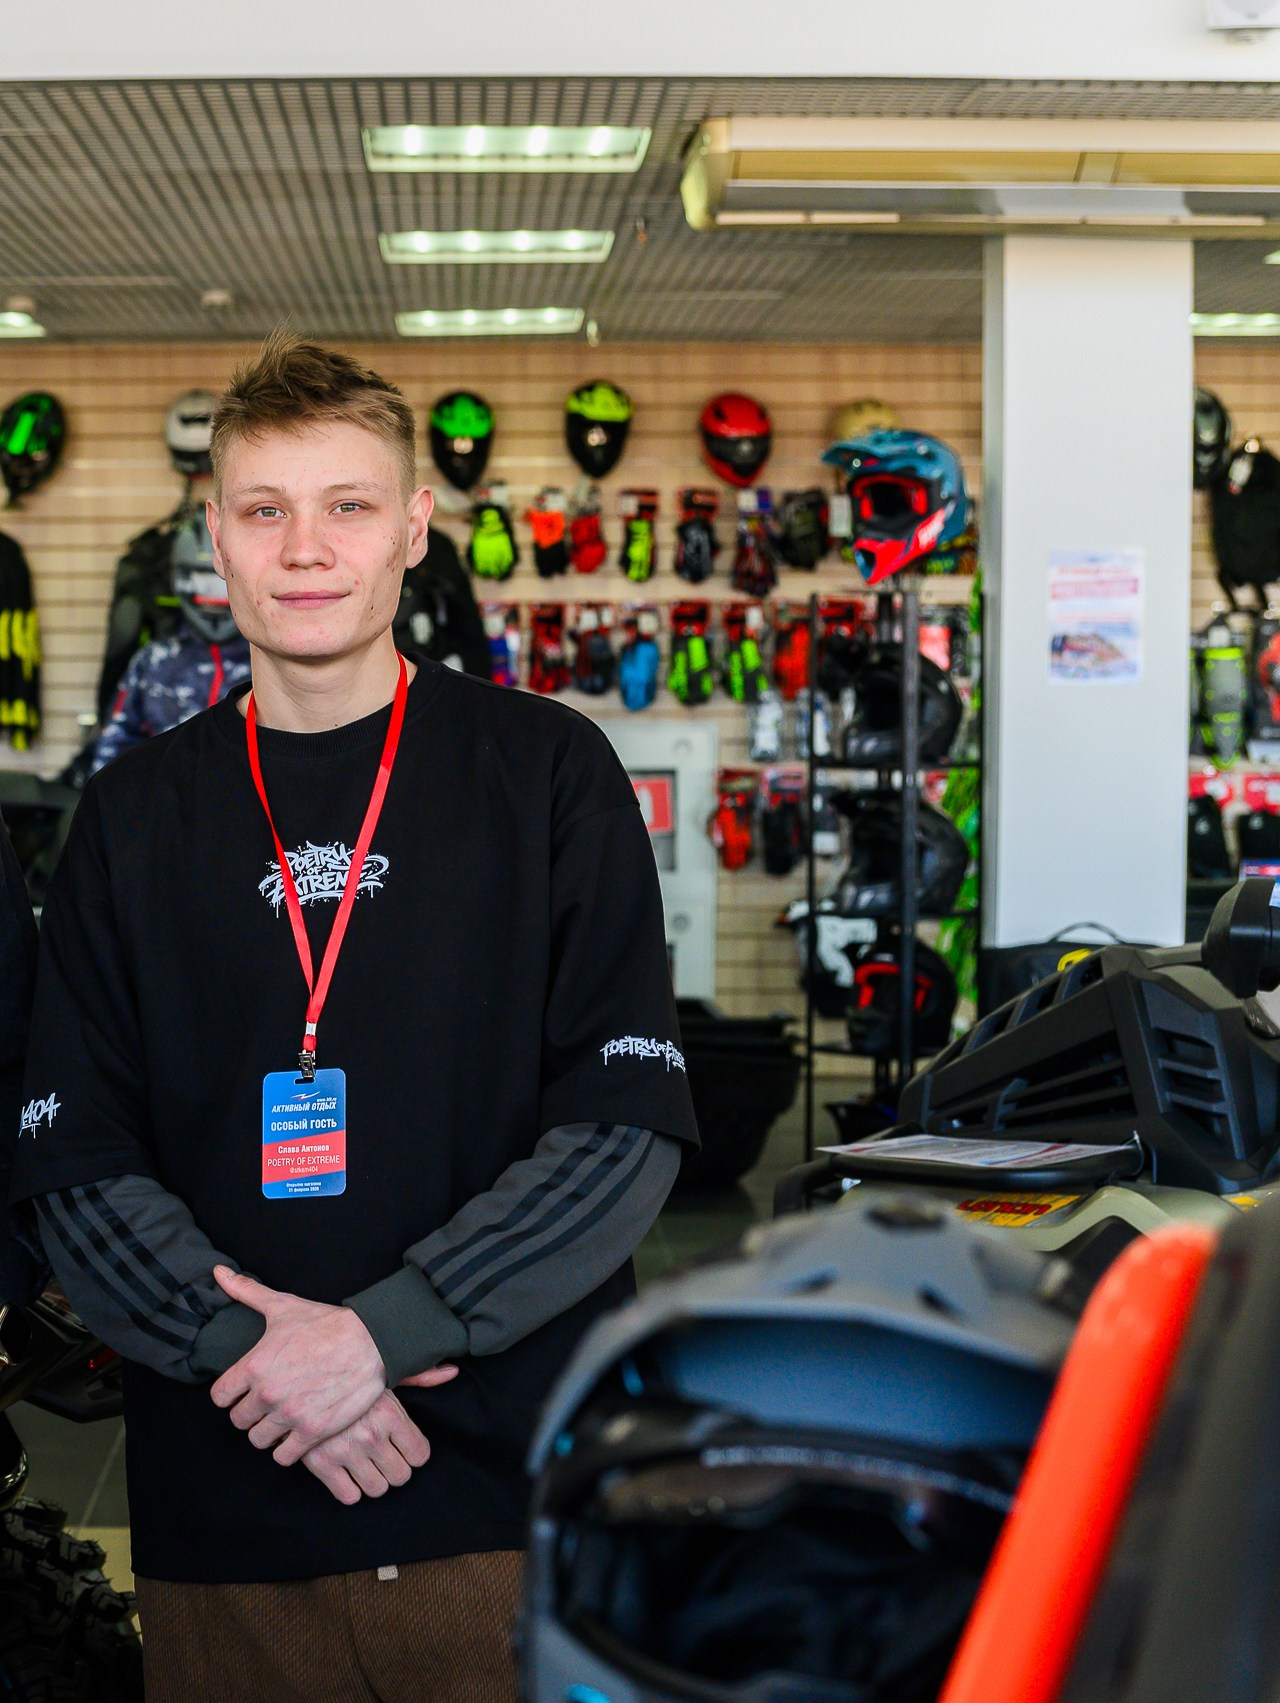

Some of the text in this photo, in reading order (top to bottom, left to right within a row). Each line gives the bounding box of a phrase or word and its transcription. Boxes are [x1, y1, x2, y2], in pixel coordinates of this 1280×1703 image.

[307, 866, 321, 875] OF
[272, 1101, 337, 1113] АКТИВНЫЙ ОТДЫХ
[270, 1118, 337, 1131] ОСОБЫЙ ГОСТЬ
[278, 1144, 330, 1154] Слава Антонов
[267, 1155, 340, 1167] POETRY OF EXTREME
